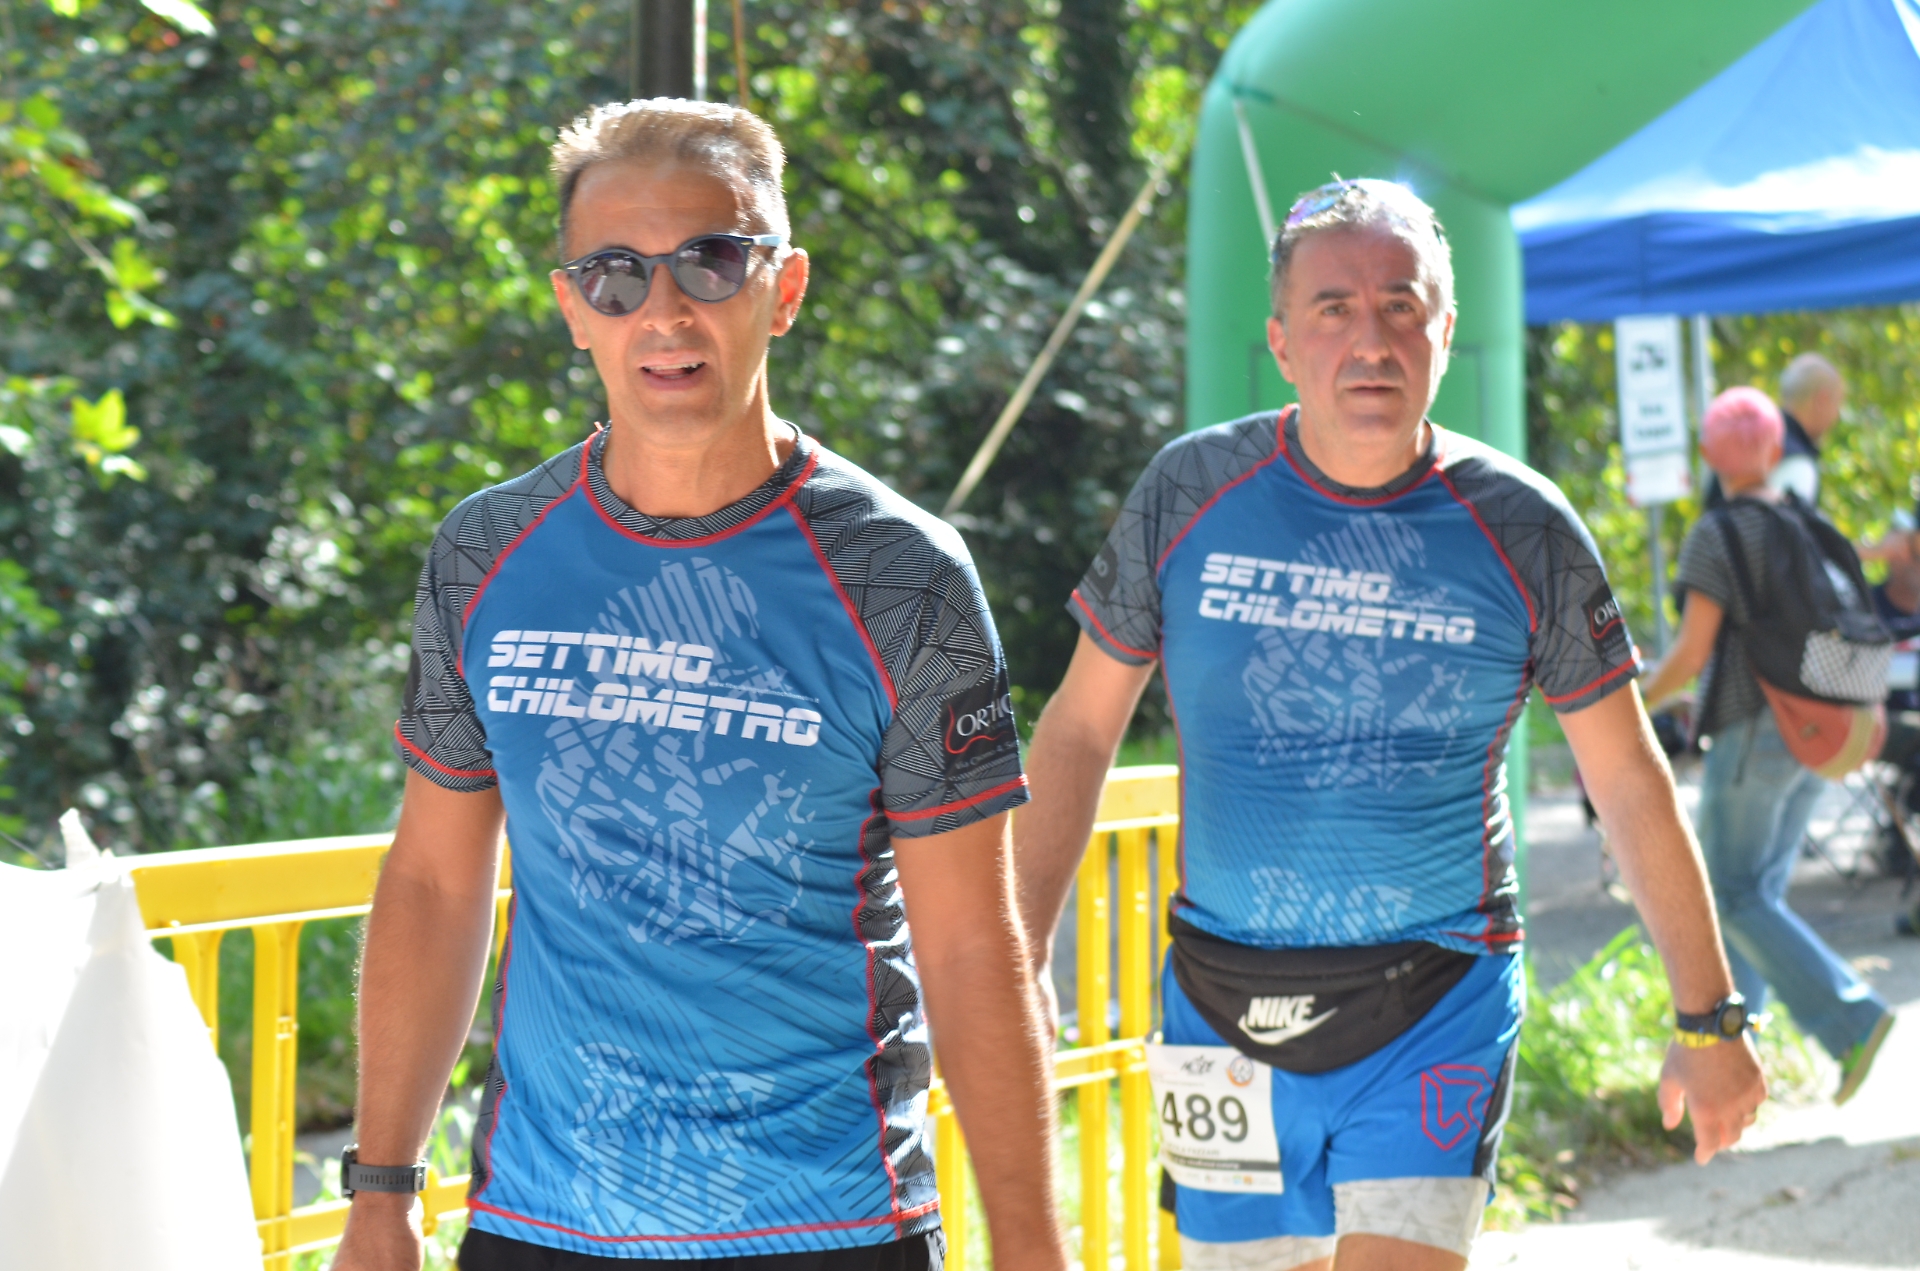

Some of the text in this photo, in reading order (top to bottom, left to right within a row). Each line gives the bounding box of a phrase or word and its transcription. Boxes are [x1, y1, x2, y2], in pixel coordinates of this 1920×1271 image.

[1200, 552, 1391, 603] SETTIMO
[1199, 588, 1476, 644] CHILOMETRO
[487, 630, 714, 684] SETTIMO
[487, 675, 822, 747] CHILOMETRO
[1248, 995, 1315, 1029] NIKE
[1162, 1092, 1249, 1143] 489
